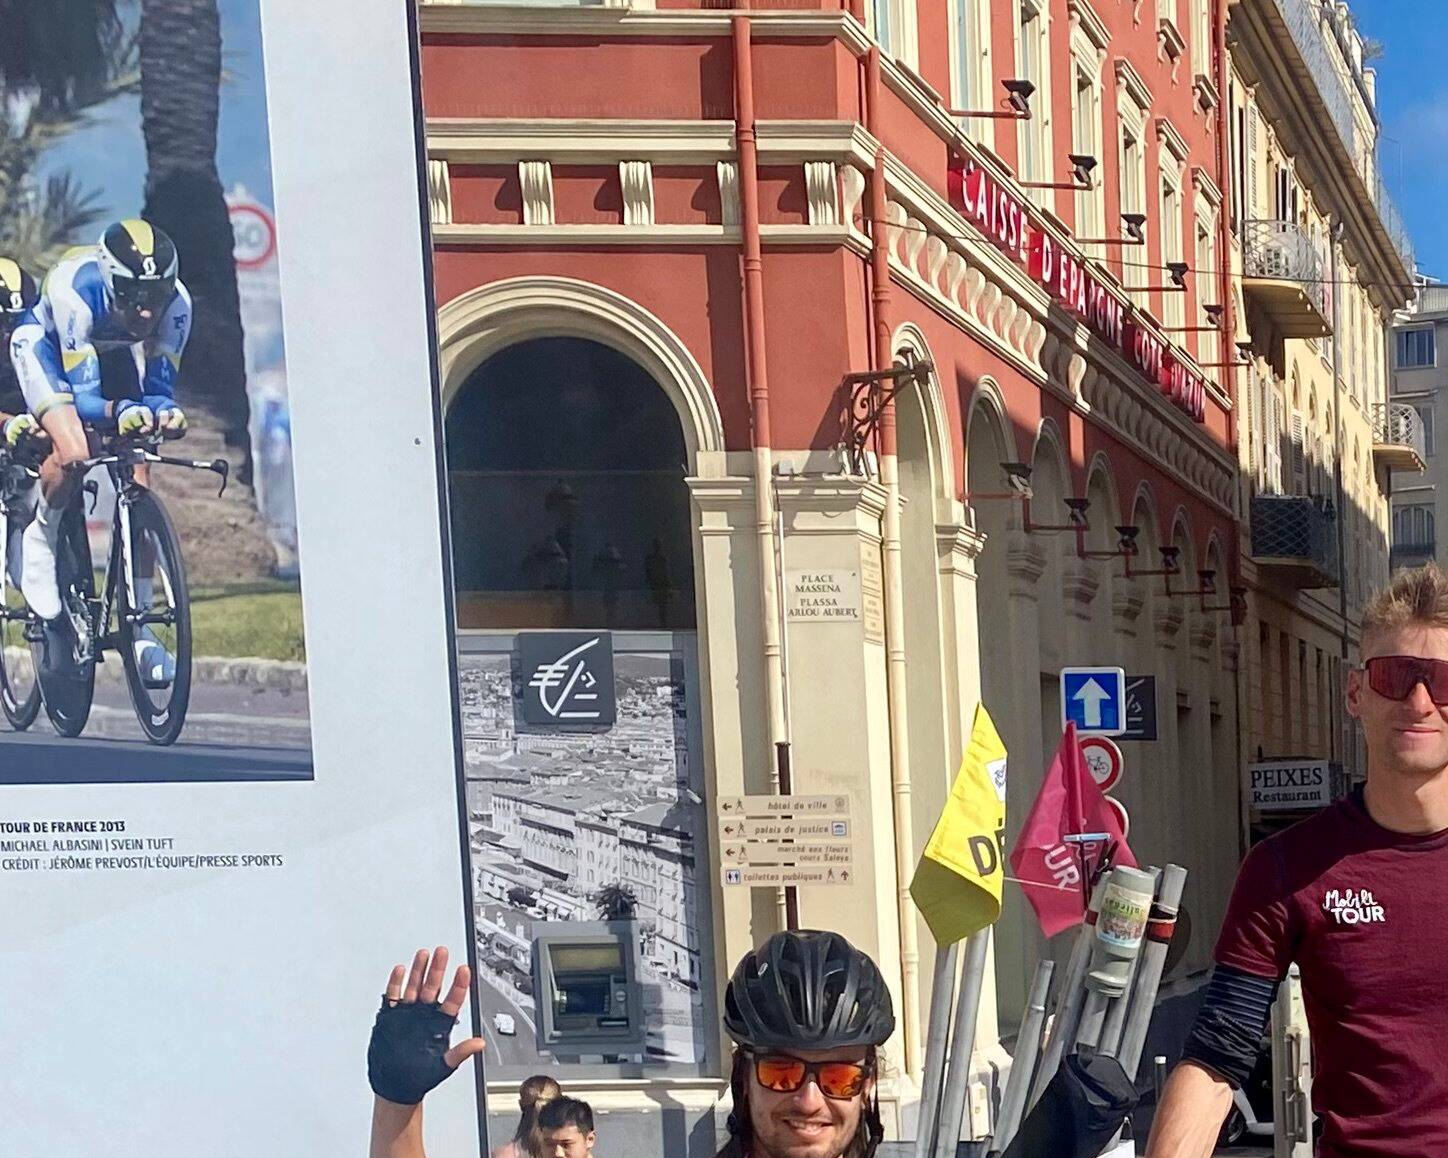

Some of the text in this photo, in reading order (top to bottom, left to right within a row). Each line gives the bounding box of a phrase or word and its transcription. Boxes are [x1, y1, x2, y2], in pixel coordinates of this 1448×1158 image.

[962, 161, 1028, 263] CAISSE
[801, 574, 834, 583] PLACE
[795, 585, 841, 593] MASSENA
[800, 598, 838, 606] PLASSA
[788, 608, 819, 616] ARLOU
[1251, 767, 1323, 788] PEIXES
[1253, 790, 1322, 803] Restaurant
[768, 801, 827, 810] hôtel de ville
[0, 820, 126, 833] TOUR DE FRANCE 2013
[798, 825, 829, 835] justice
[1, 839, 49, 852] MICHAEL
[53, 838, 103, 851] ALBASINI
[111, 838, 143, 851] SVEIN
[146, 838, 174, 850] TUFT
[2, 856, 39, 870] CRÉDIT
[49, 855, 92, 870] JÉRÔME
[242, 854, 283, 868] SPORTS
[1331, 906, 1385, 924] TOUR
